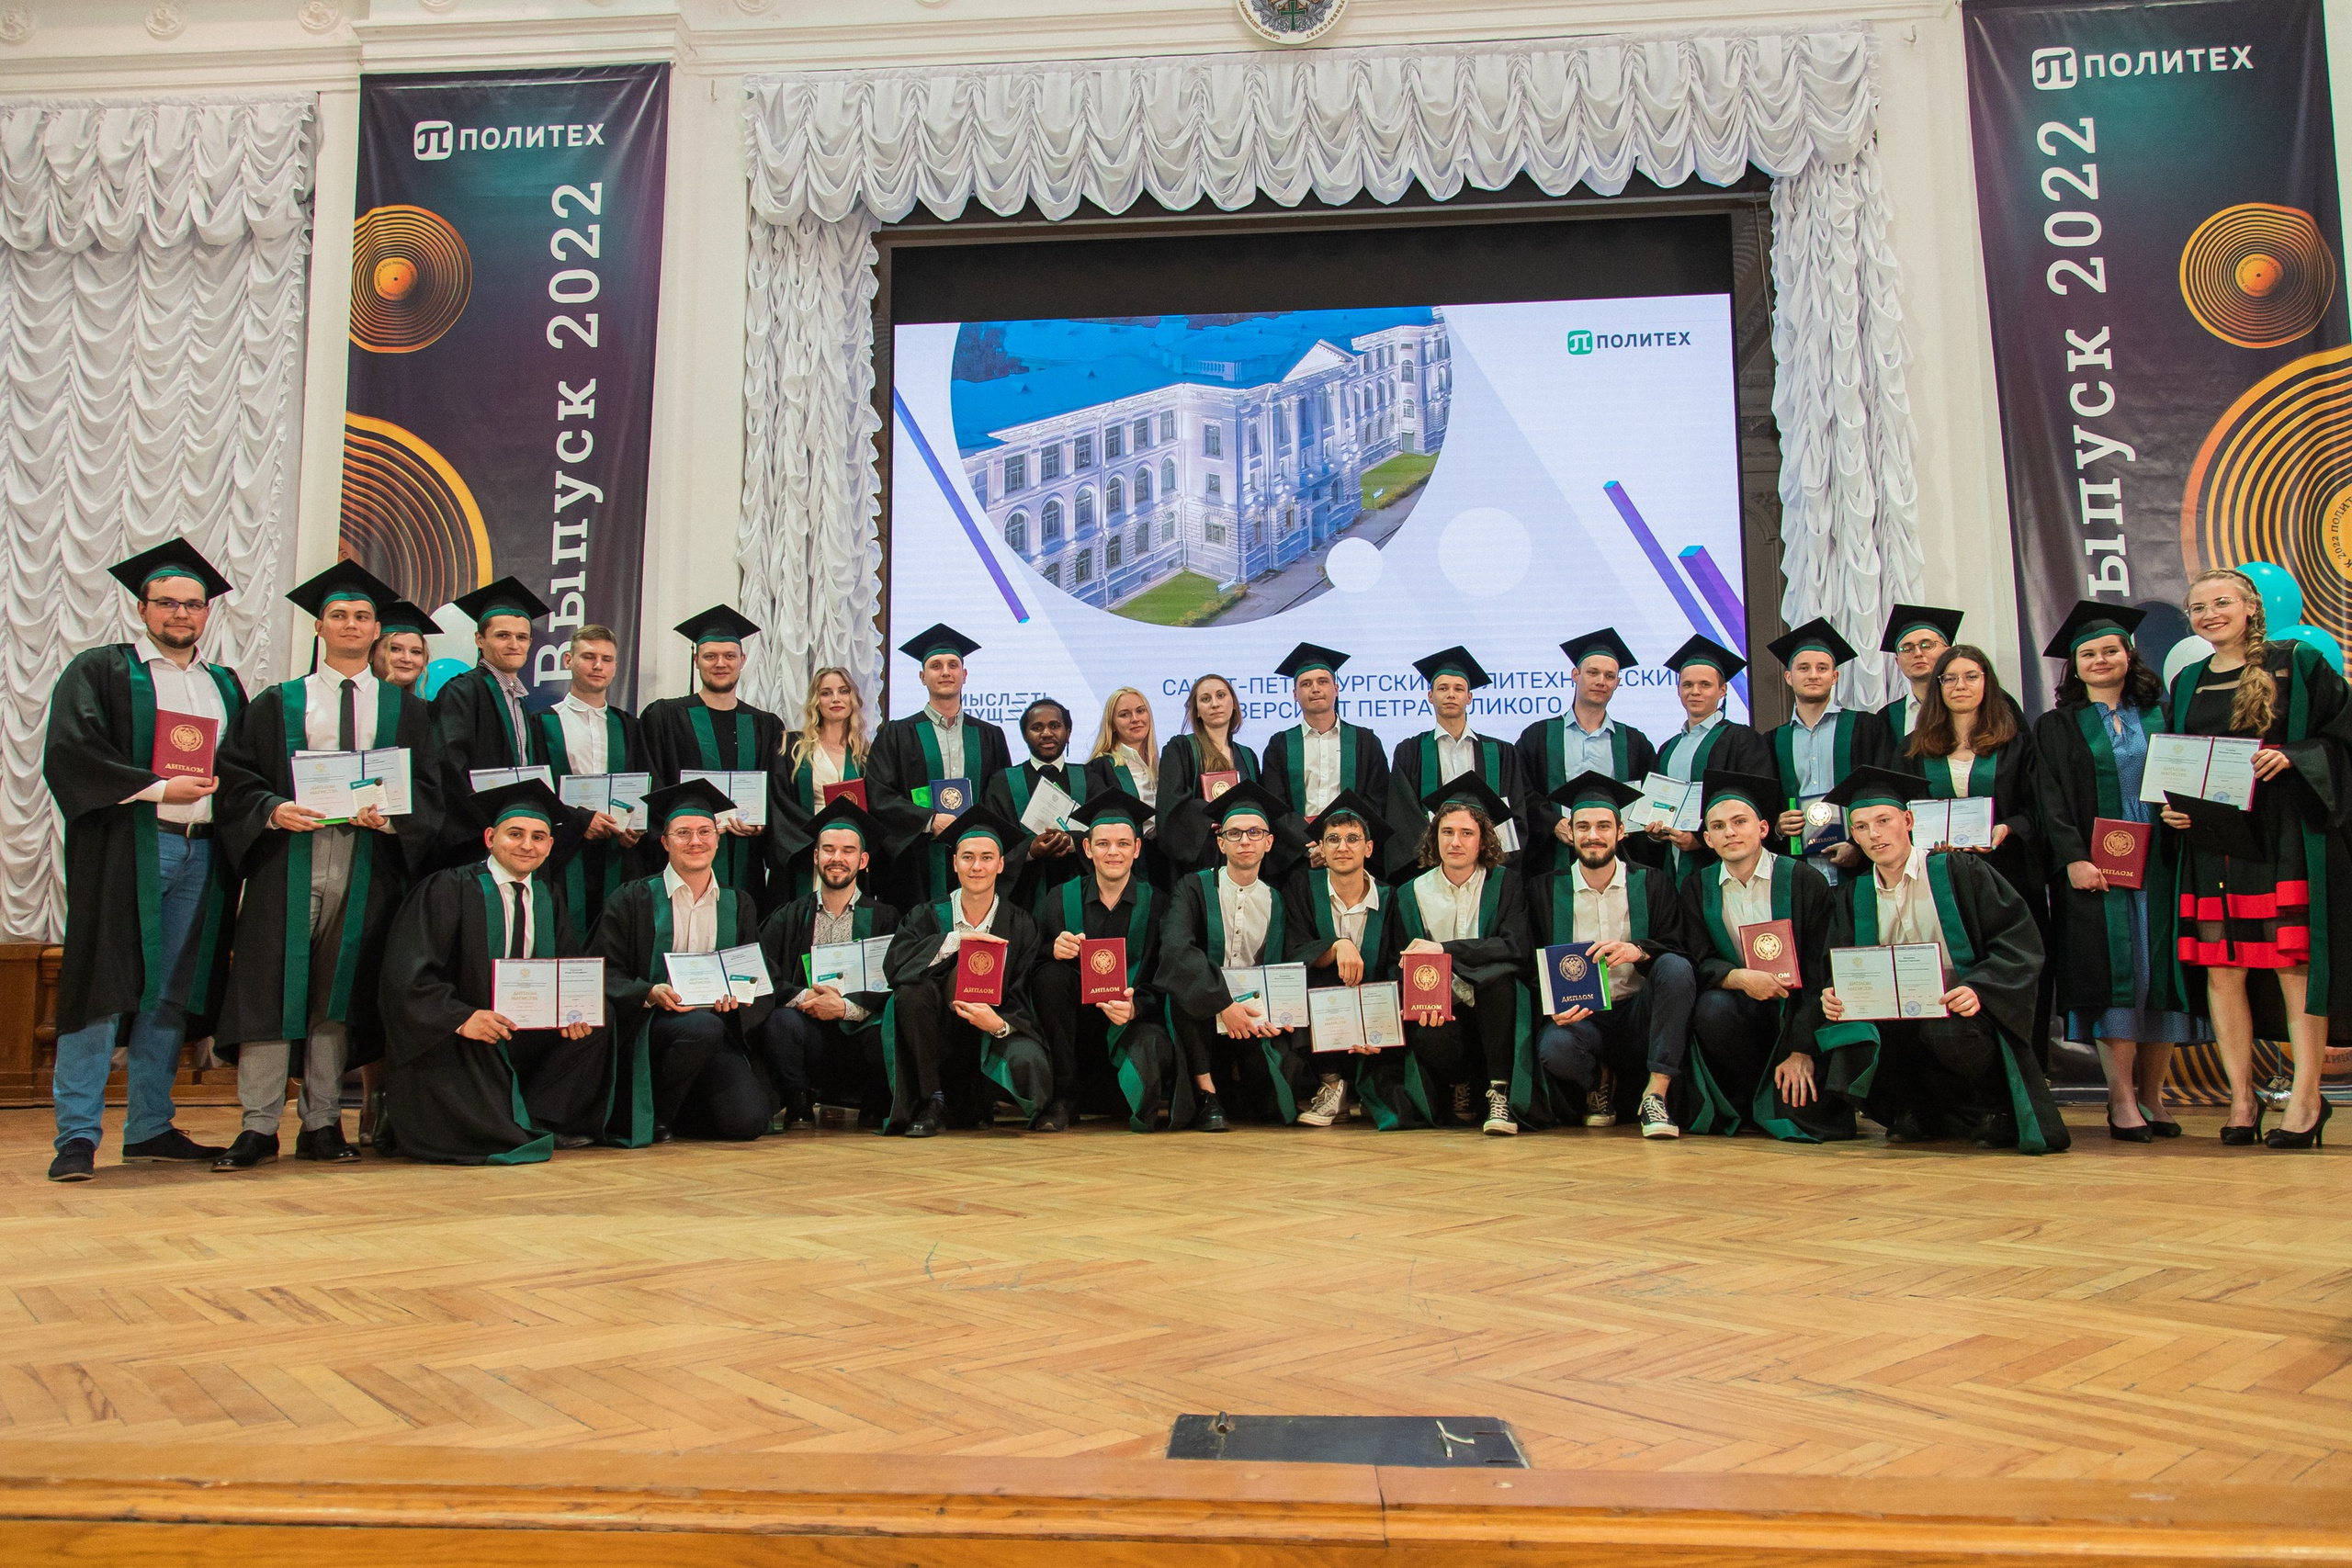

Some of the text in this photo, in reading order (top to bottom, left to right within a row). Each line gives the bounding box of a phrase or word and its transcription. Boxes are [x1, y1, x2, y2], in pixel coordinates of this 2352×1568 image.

[2084, 45, 2254, 79] ПОЛИТЕХ
[459, 123, 605, 151] ПОЛИТЕХ
[546, 182, 603, 349] 2022
[1596, 332, 1691, 349] ПОЛИТЕХ
[2036, 118, 2136, 597] ыпуск 2022
[1359, 699, 1432, 717] ПЕТРА
[1468, 696, 1562, 716] ЛИКОГО
[164, 762, 205, 773] ДИПЛОМ
[963, 987, 995, 995] ДИПЛОМ
[1090, 986, 1121, 995] ДИПЛОМ
[1562, 993, 1594, 1003] ДИПЛОМ
